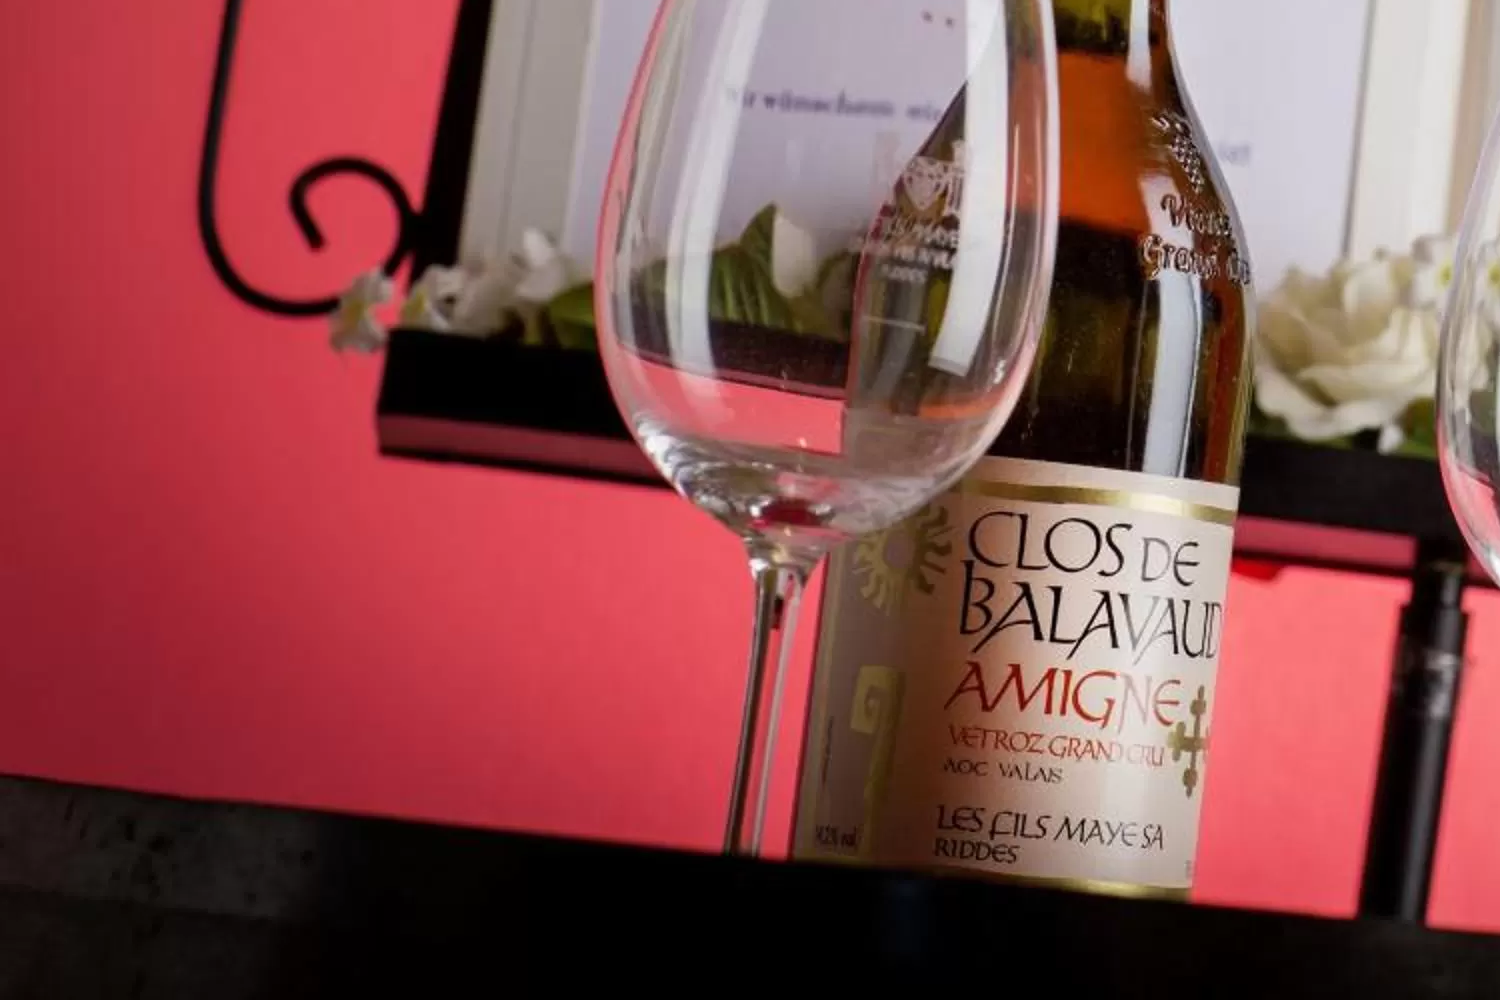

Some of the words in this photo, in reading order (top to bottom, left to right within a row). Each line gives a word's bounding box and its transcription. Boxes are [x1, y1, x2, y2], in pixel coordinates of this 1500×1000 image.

[968, 511, 1133, 577] CLOS
[1140, 537, 1200, 587] DE
[959, 560, 1223, 666] BALAVAUD
[943, 660, 1181, 735] AMIGNE
[943, 757, 988, 777] AOC
[999, 761, 1063, 784] VALAIS
[1048, 735, 1122, 763] GRAND
[1126, 743, 1165, 767] CRU
[937, 804, 985, 833] LES
[988, 811, 1052, 841] FILS
[1053, 816, 1137, 847] MAYE
[1140, 823, 1164, 850] SA
[934, 838, 1021, 865] RIDDES
